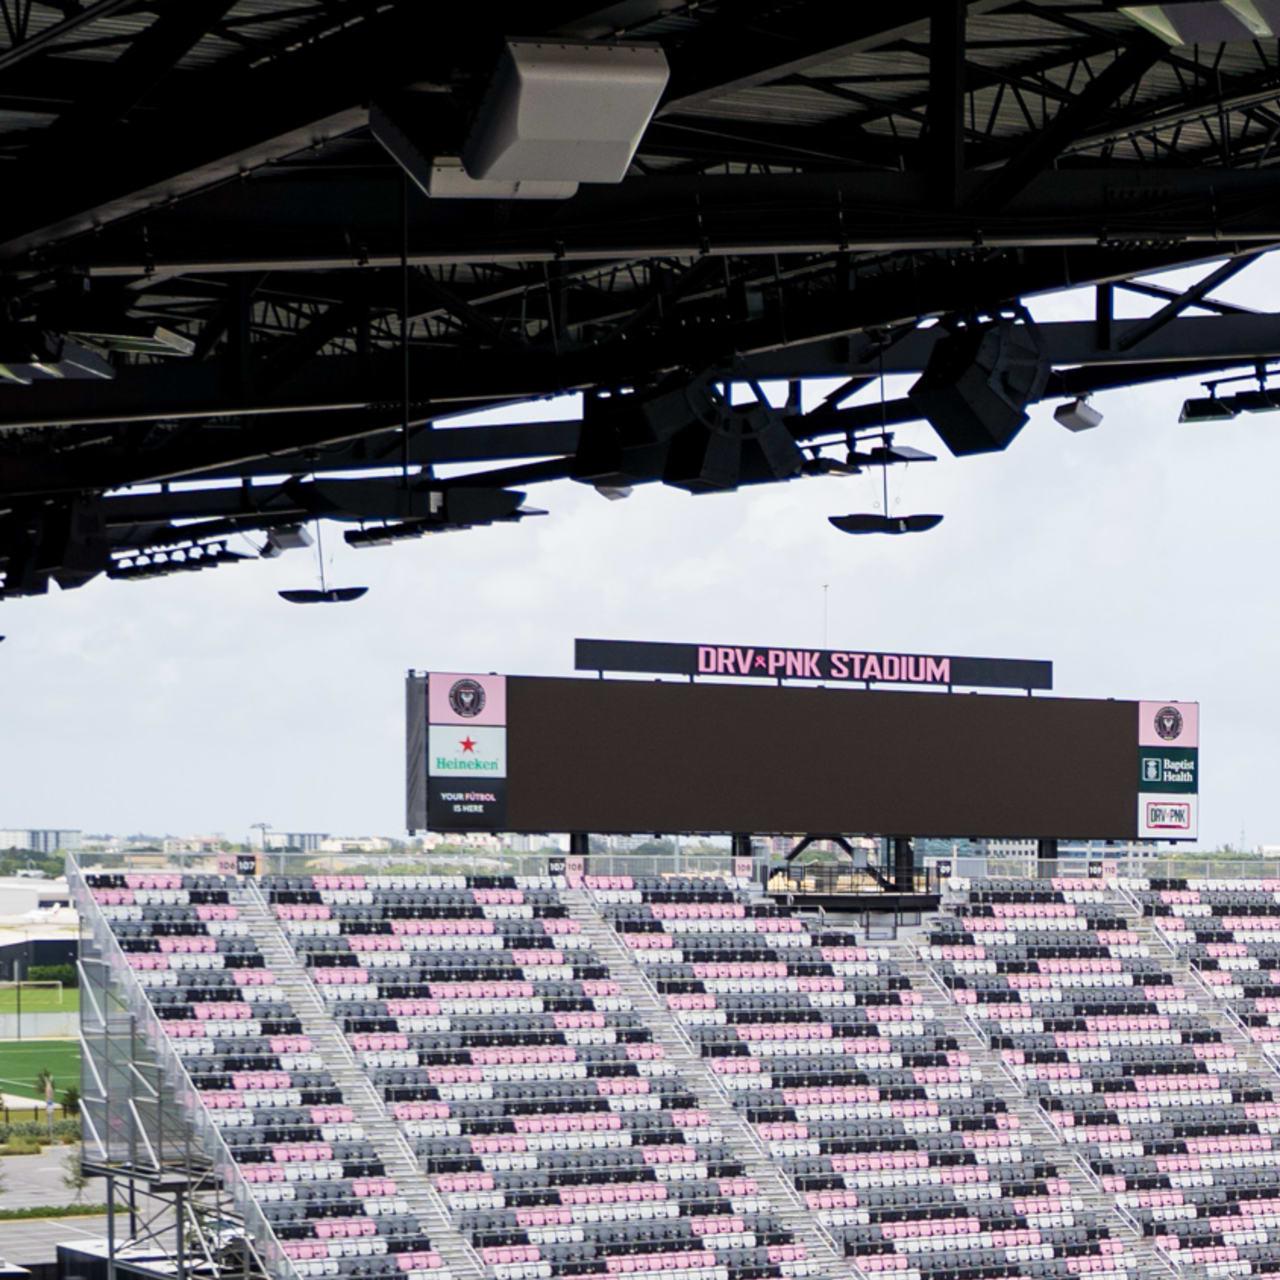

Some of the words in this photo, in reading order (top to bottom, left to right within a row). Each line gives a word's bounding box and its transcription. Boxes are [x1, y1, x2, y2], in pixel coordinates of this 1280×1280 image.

[698, 647, 754, 675] DRV
[768, 651, 821, 678] PNK
[830, 652, 951, 682] STADIUM
[436, 757, 498, 771] Heineken
[1163, 758, 1195, 772] Baptist
[1163, 771, 1193, 782] Health
[441, 792, 464, 802] YOUR
[453, 804, 461, 813] IS
[462, 804, 484, 813] HERE
[1169, 808, 1186, 824] PNK
